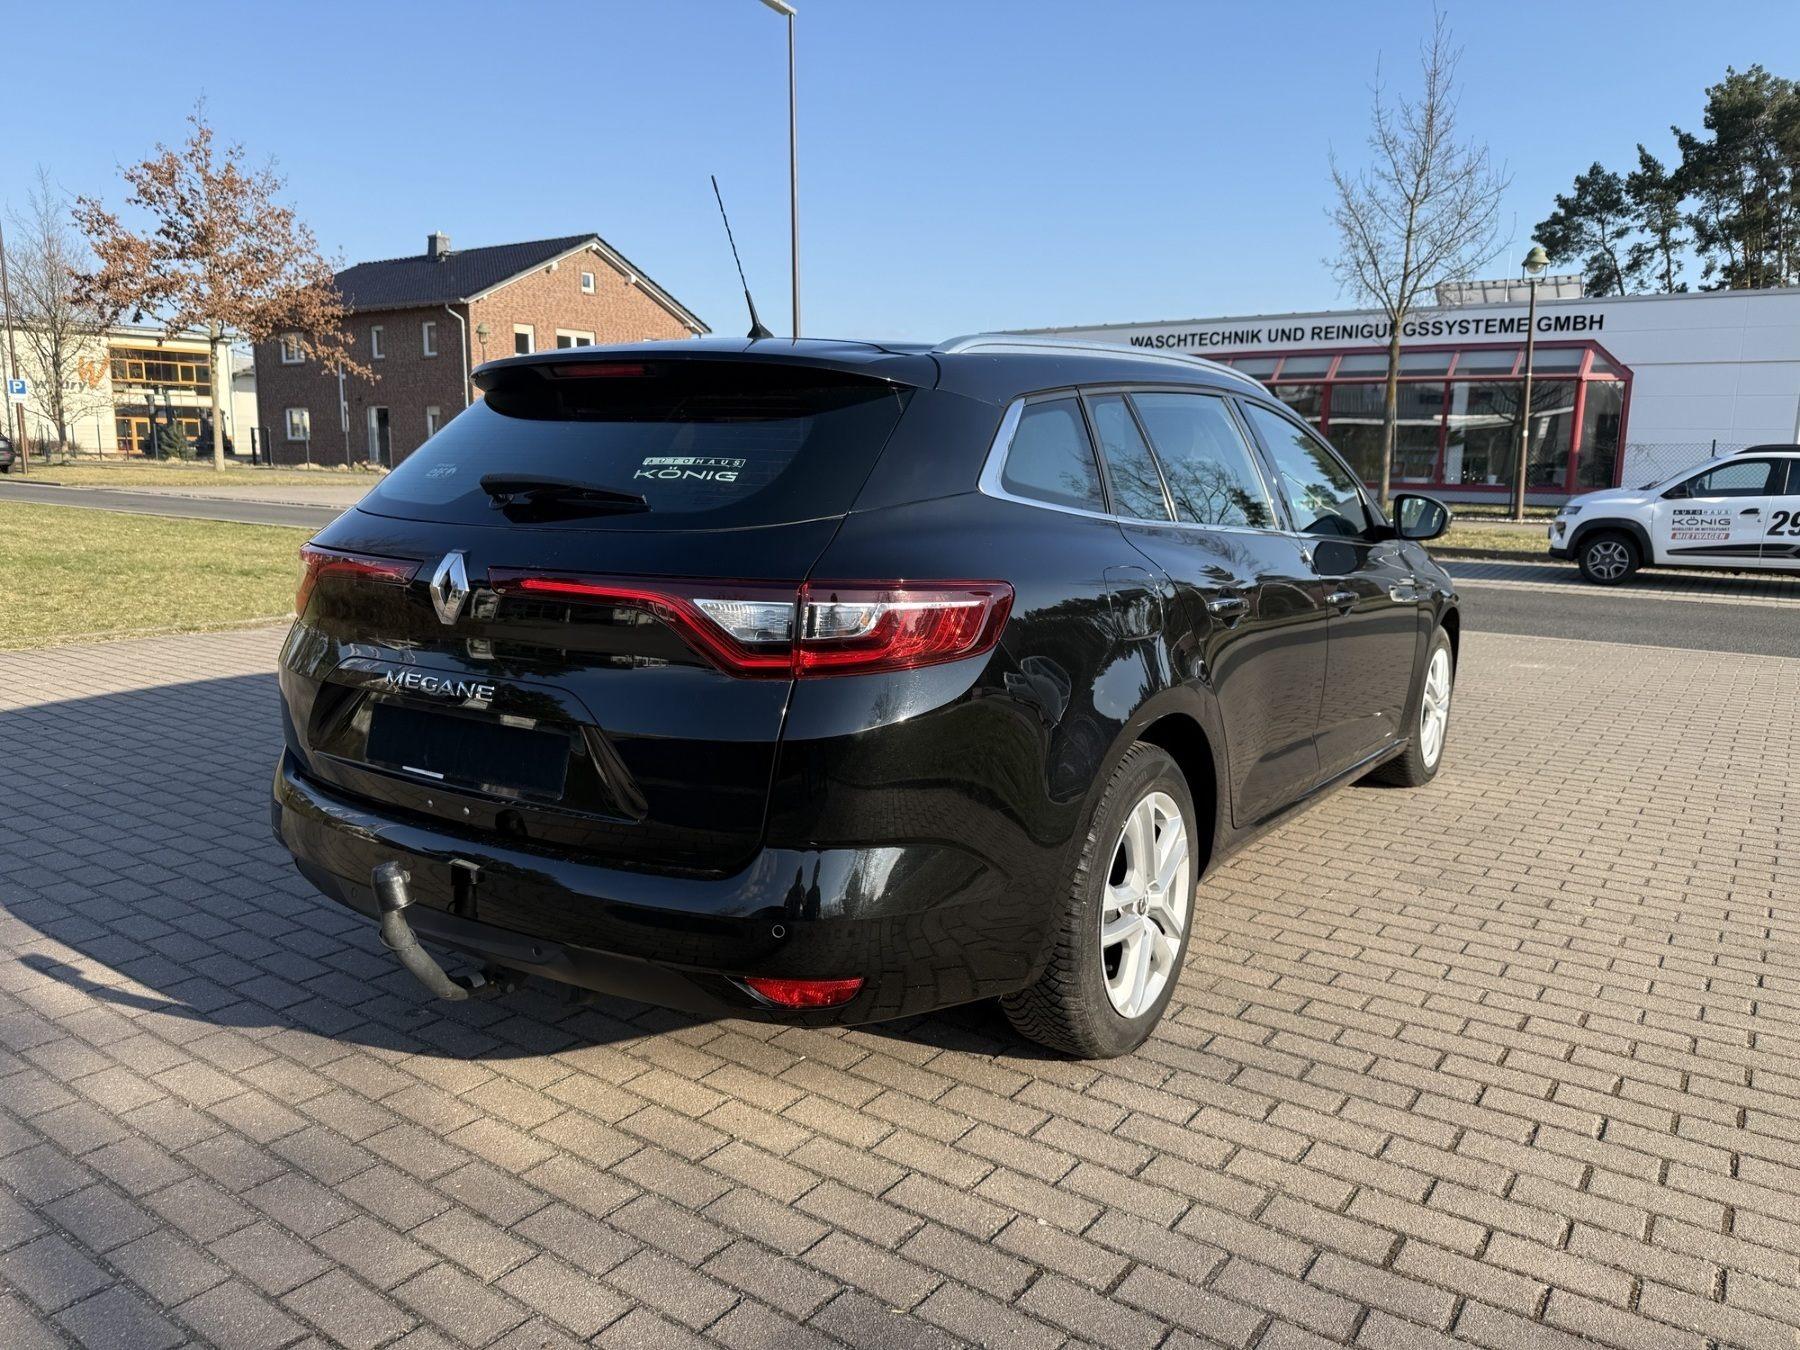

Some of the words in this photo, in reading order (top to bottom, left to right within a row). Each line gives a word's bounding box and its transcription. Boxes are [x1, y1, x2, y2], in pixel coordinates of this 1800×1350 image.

[1130, 329, 1262, 349] WASCHTECHNIK
[1267, 328, 1305, 343] UND
[1536, 314, 1604, 332] GMBH
[13, 381, 23, 393] P
[633, 466, 739, 482] KÖNIG
[1672, 516, 1731, 526] KÖNIG
[384, 669, 495, 703] MEGANE
